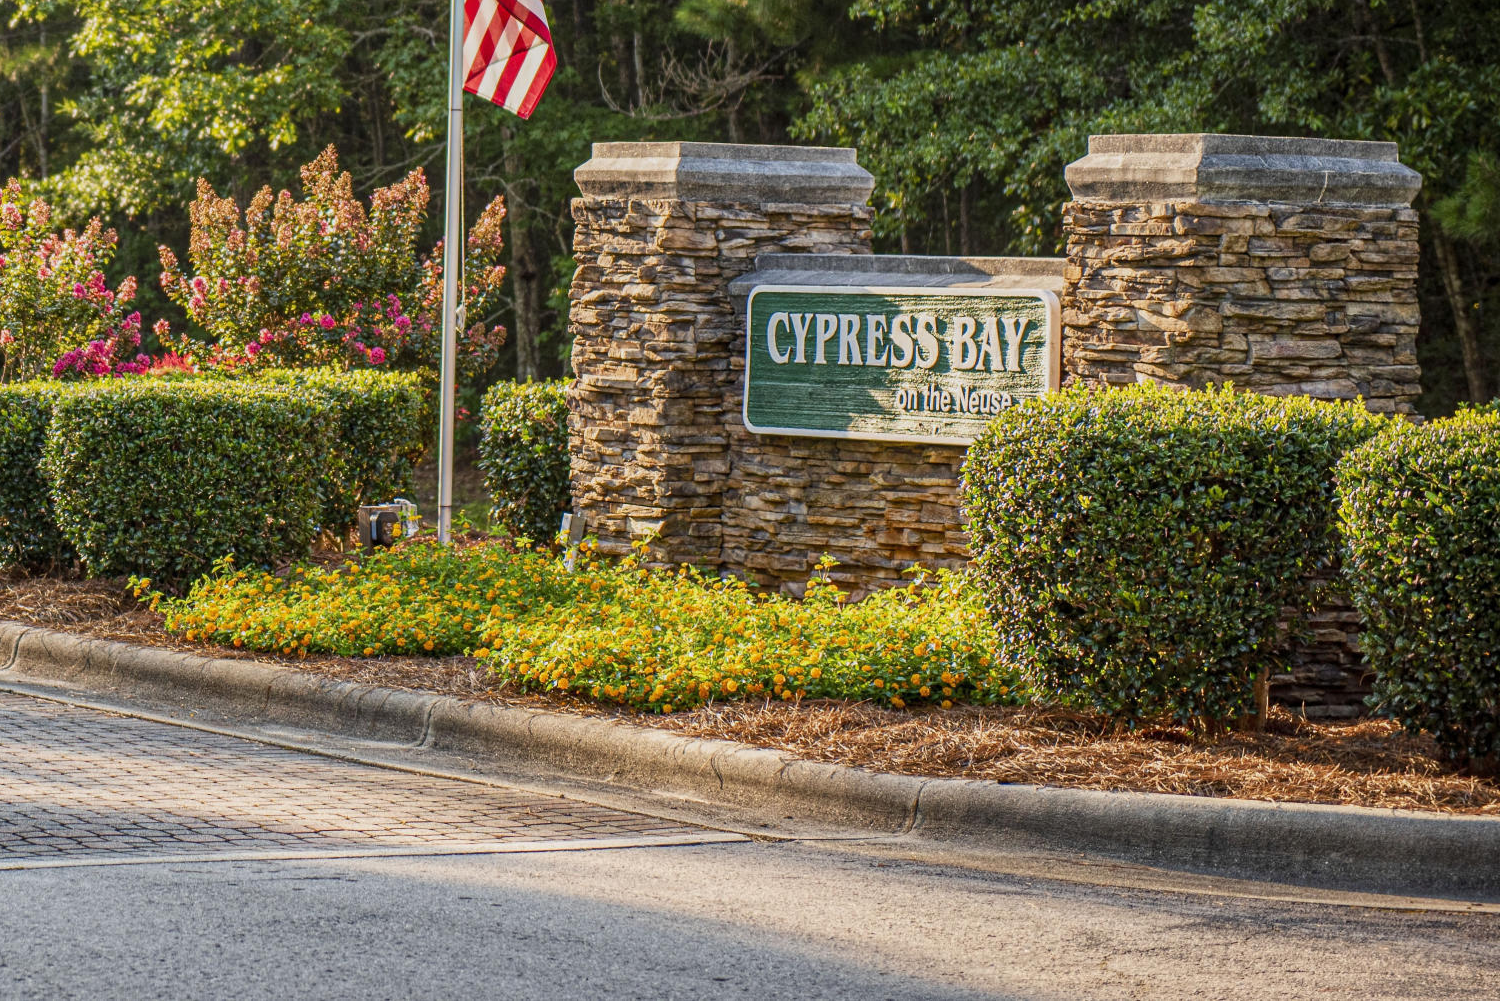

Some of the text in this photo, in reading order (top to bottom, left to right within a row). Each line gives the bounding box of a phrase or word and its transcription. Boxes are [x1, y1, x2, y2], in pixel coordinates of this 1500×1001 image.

[767, 311, 1029, 372] CYPRESS BAY
[897, 383, 1012, 414] on the Neuse
